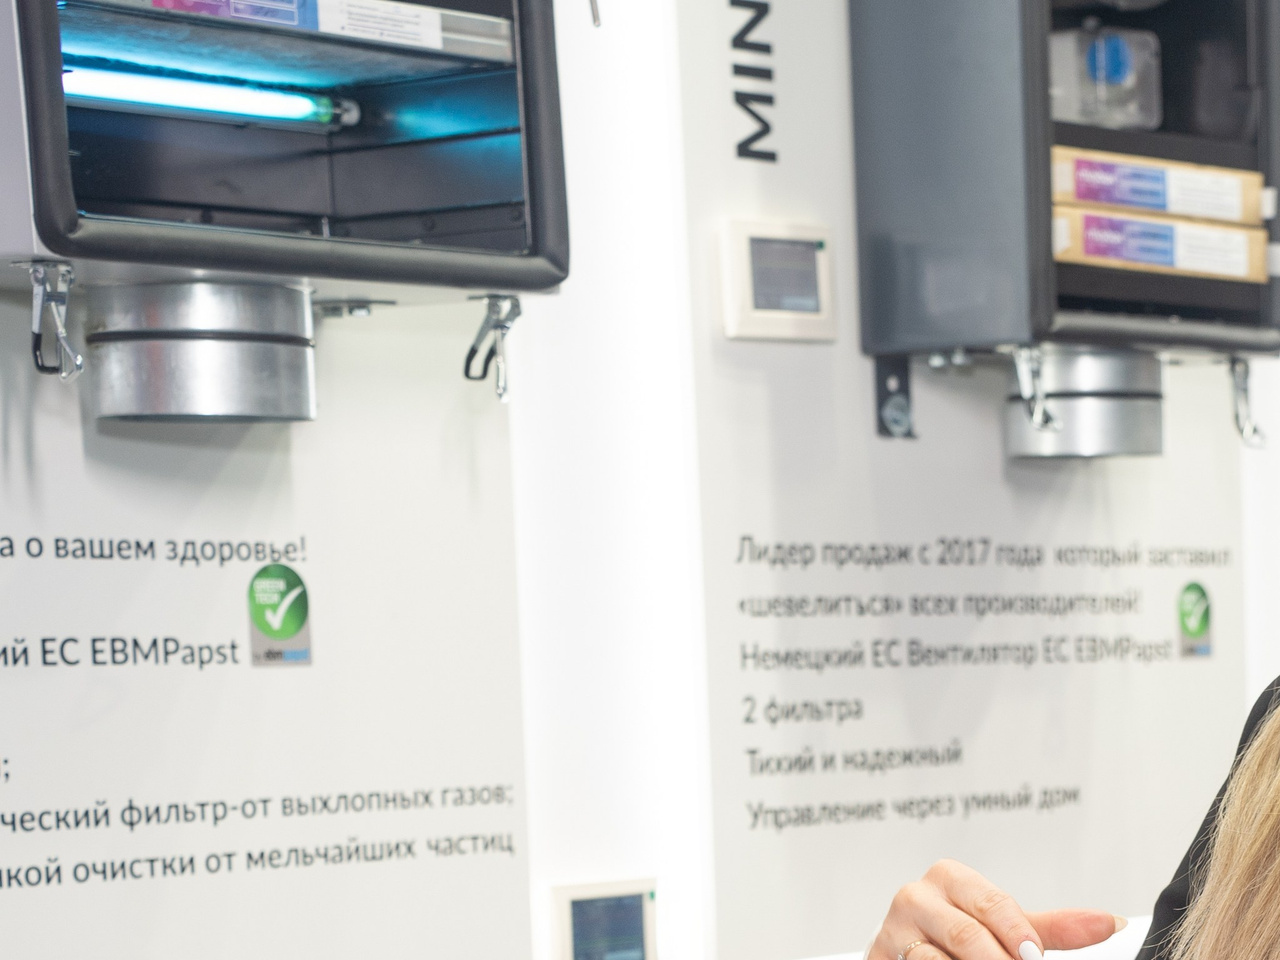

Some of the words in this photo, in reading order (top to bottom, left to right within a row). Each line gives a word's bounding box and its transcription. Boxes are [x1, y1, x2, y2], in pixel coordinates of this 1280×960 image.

[730, 0, 777, 162] MIN
[26, 537, 44, 559] о
[55, 537, 157, 560] вашем
[166, 537, 307, 567] здоровье!
[737, 536, 817, 570] Лидер
[822, 541, 914, 571] продаж
[936, 537, 992, 568] 2017
[996, 544, 1045, 571] года
[1053, 542, 1141, 570] который
[910, 595, 959, 617] всех
[91, 636, 240, 671] EBMPapst
[741, 641, 865, 674] Немецкий
[908, 637, 1037, 671] Вентилятор
[742, 695, 758, 724] 2
[764, 696, 864, 727] фильтра
[745, 745, 814, 776] Тихий
[821, 753, 836, 773] и
[843, 739, 963, 774] надежный
[121, 799, 271, 828] фильтр-от
[281, 789, 434, 818] выхлопных
[440, 783, 514, 810] газов;
[746, 798, 886, 834] Управление
[892, 795, 955, 823] через
[961, 783, 1033, 816] умный
[1037, 785, 1081, 812] дом
[0, 857, 62, 888] кой
[73, 855, 197, 886] очистки
[205, 851, 237, 875] от
[246, 836, 416, 871] мельчайших
[426, 831, 516, 861] частиц
